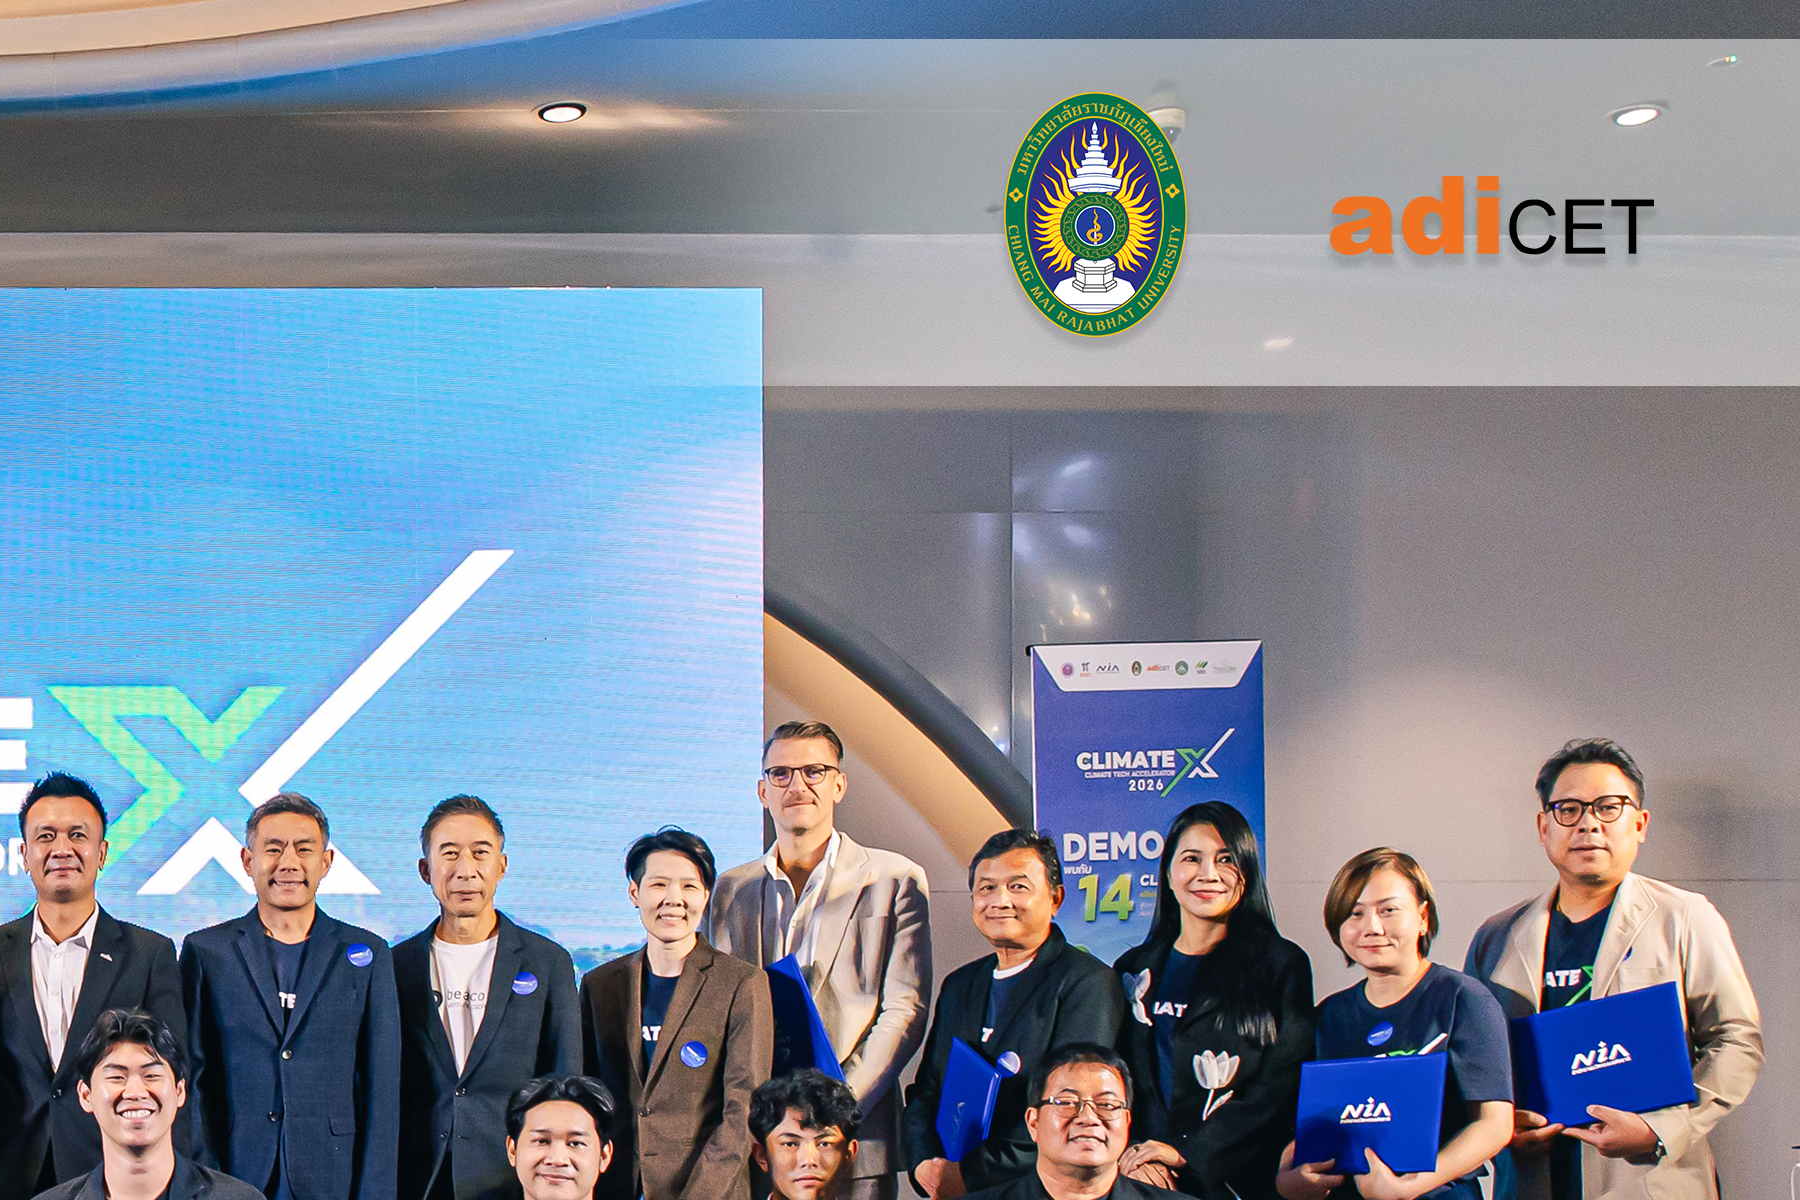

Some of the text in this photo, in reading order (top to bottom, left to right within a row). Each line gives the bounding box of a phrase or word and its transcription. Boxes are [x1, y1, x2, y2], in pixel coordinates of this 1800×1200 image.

[1128, 778, 1165, 792] 2026
[1062, 829, 1165, 862] DEMO
[1078, 873, 1135, 922] 14
